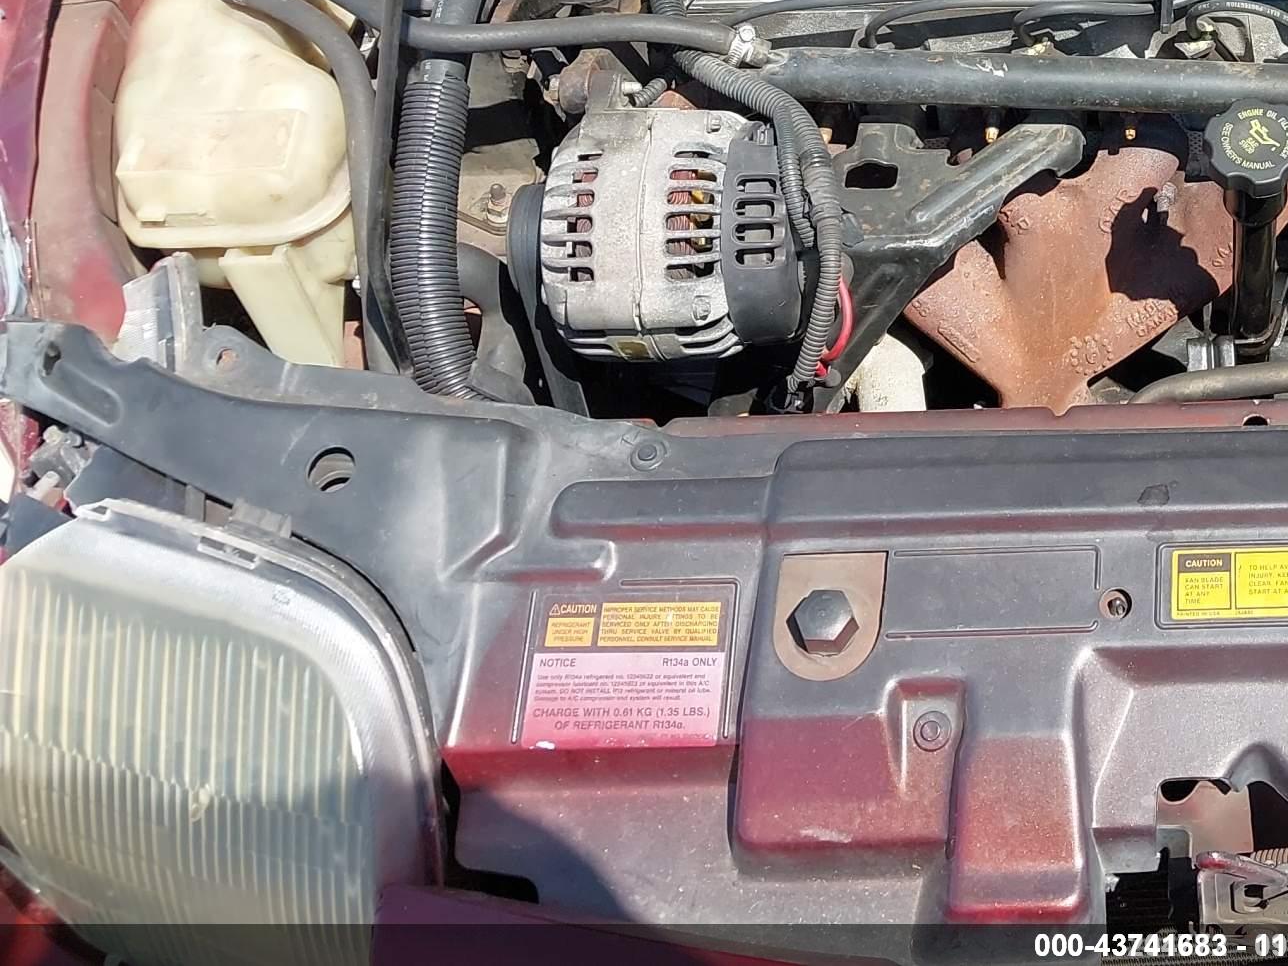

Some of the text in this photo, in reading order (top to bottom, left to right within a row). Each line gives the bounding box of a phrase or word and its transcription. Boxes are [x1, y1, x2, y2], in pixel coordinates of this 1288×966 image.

[1237, 108, 1264, 120] ENGINE
[1266, 110, 1278, 120] OIL
[1221, 122, 1234, 137] SEE
[1241, 160, 1276, 169] MANUAL
[1185, 559, 1222, 568] CAUTION
[560, 604, 597, 614] CAUTION
[539, 658, 577, 667] NOTICE
[662, 658, 718, 666] R134a ONLY
[533, 707, 711, 718] CHARGE WITH 0.61 KG (1.35 LBS.)
[554, 721, 570, 730] OF
[574, 720, 650, 730] REFRIGERANT
